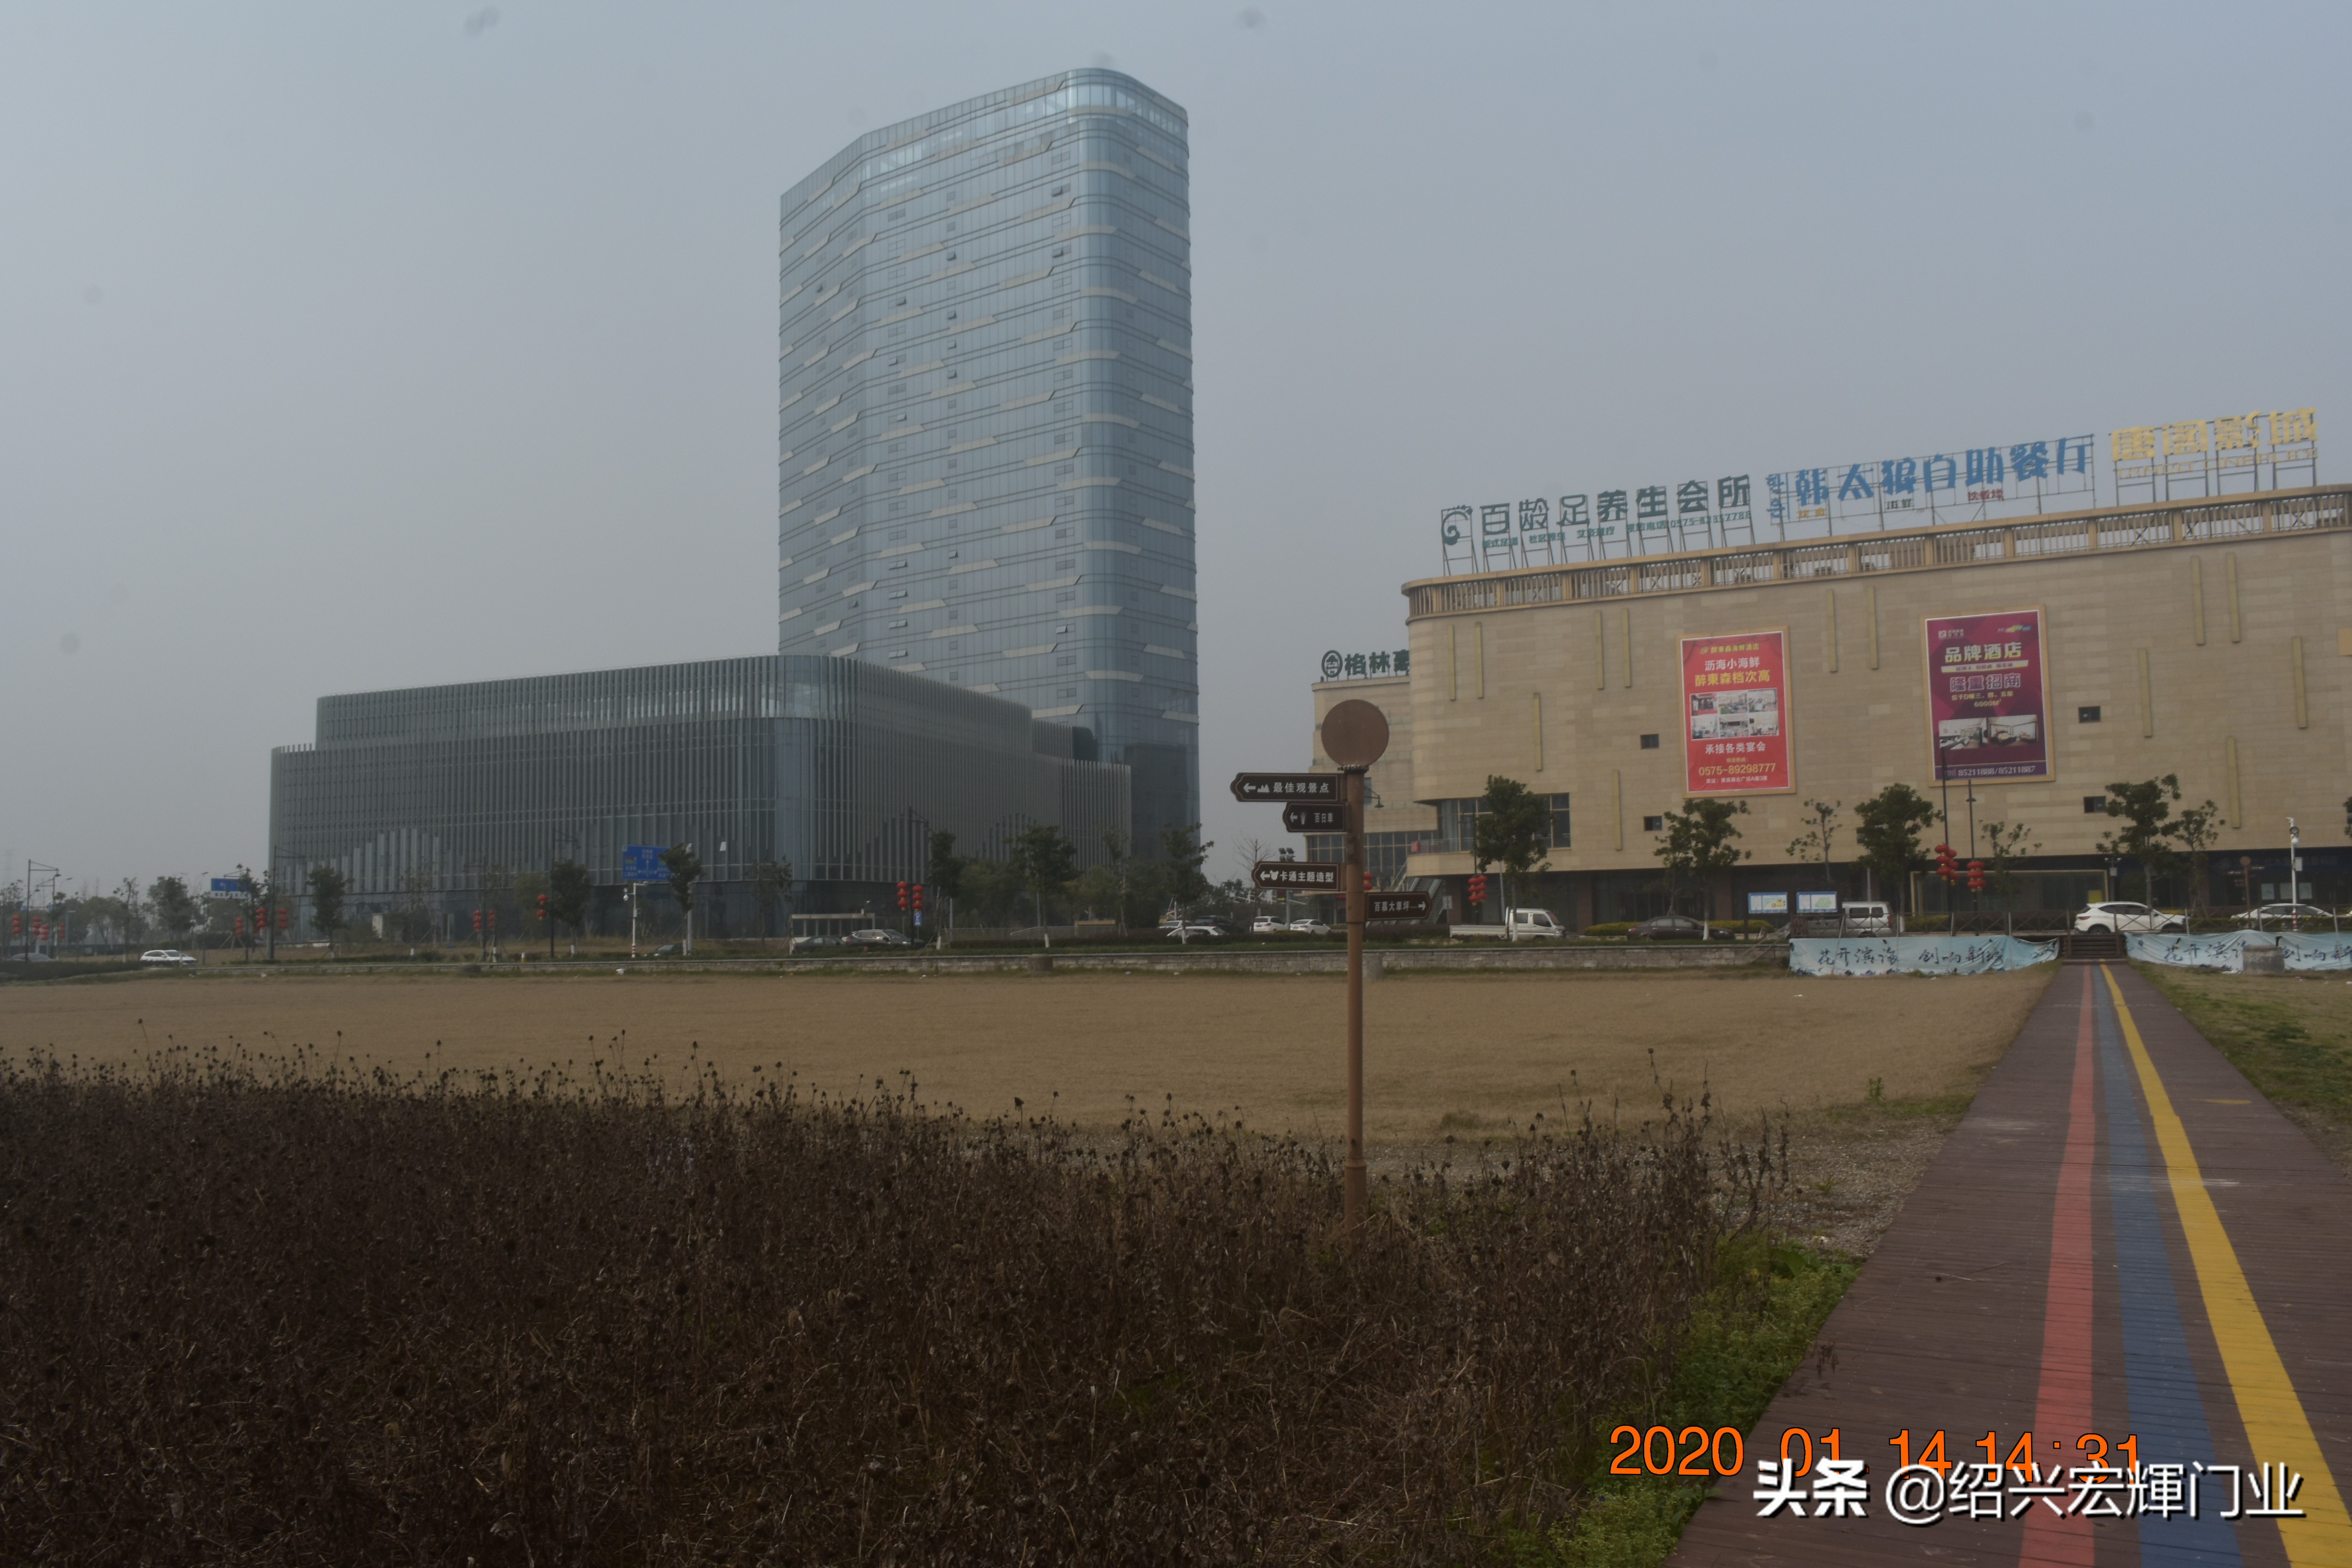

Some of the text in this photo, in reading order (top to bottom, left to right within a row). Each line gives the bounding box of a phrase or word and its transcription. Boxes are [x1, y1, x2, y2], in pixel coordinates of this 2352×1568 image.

[1480, 474, 1750, 535] 百龄足养生会所
[1945, 641, 2022, 663] 品牌酒店
[1949, 672, 2021, 693] 隆重招商
[1705, 741, 1766, 755] 承接各类宴会
[1698, 763, 1776, 776] 0575-89298777
[1273, 782, 1329, 793] 最佳观景点
[1314, 813, 1333, 823] 百日草
[1279, 870, 1334, 882] 卡通主题造型
[1818, 946, 1898, 966] 花开滨海
